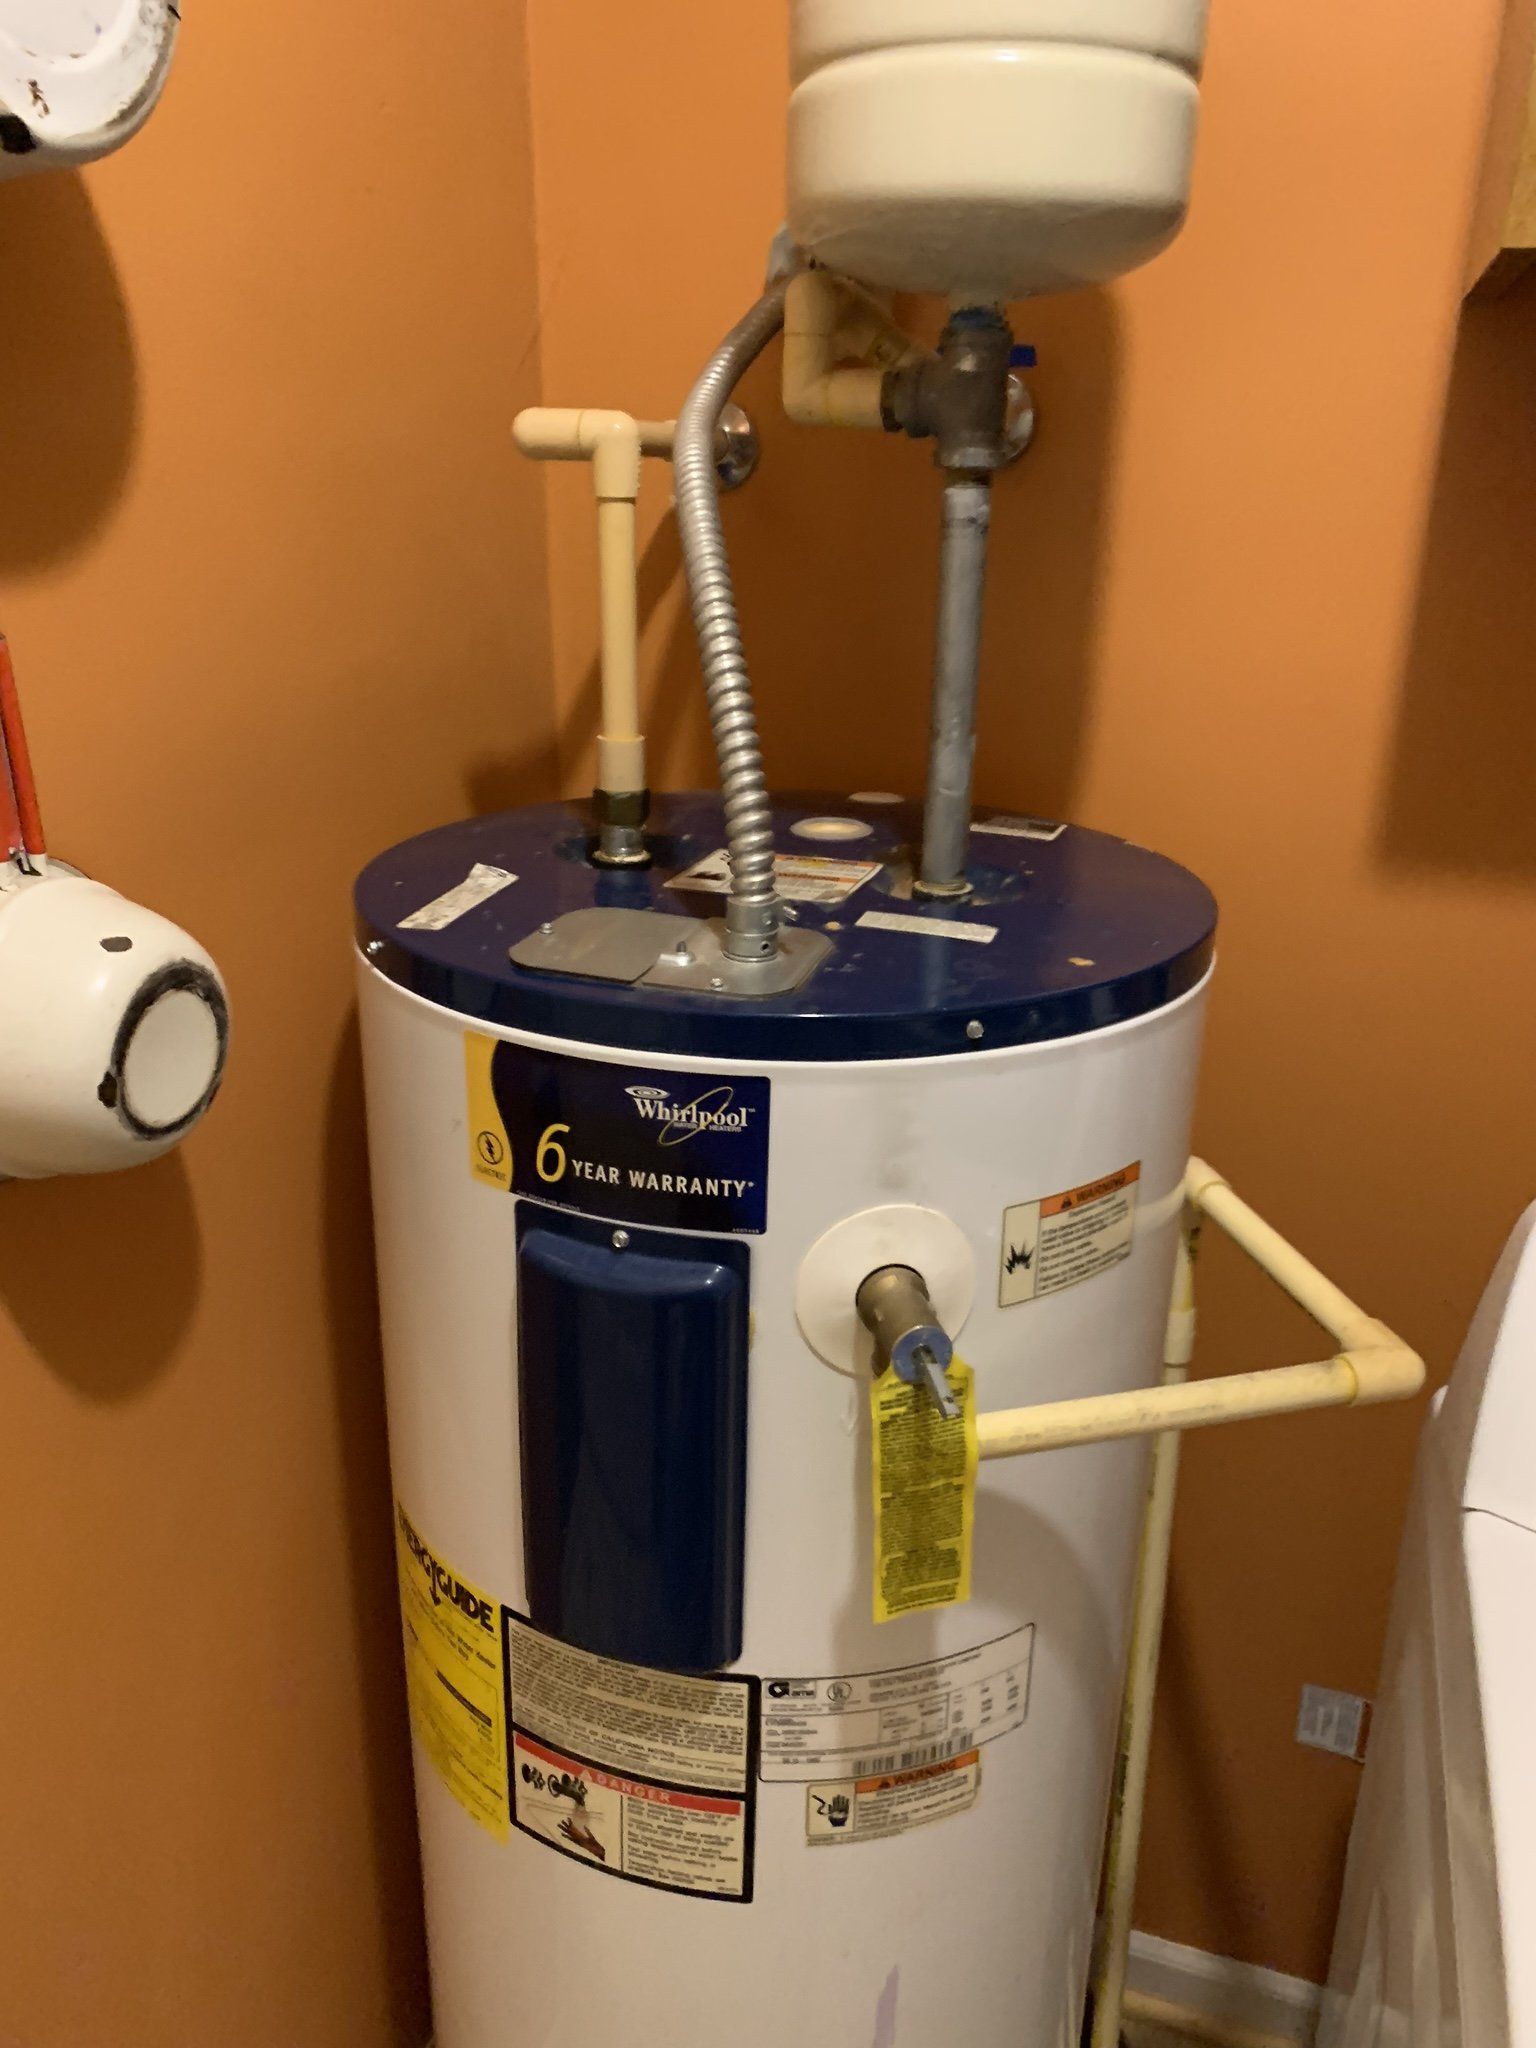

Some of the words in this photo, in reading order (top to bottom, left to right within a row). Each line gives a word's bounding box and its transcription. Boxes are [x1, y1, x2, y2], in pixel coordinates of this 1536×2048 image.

[536, 1123, 570, 1183] 6
[572, 1160, 620, 1184] YEAR
[597, 1773, 671, 1804] DANGER
